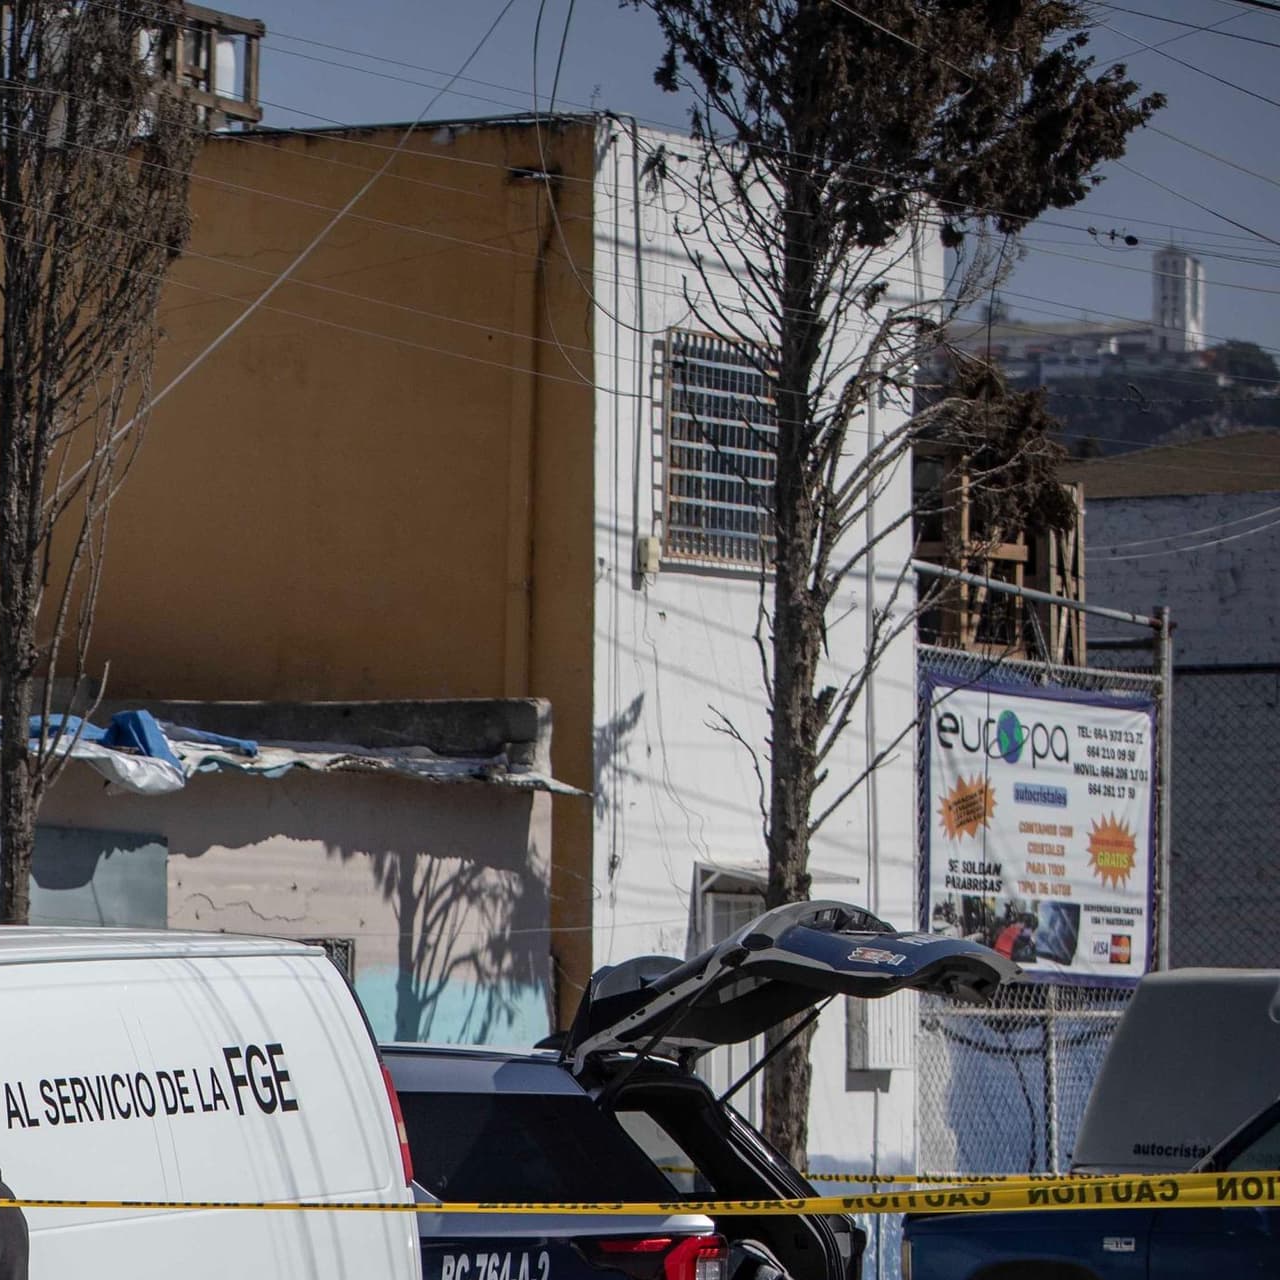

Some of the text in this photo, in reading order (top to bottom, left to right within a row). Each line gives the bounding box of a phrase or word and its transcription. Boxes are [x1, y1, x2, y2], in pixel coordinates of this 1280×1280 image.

[937, 710, 1070, 769] europa
[945, 874, 1003, 892] PARABRISAS
[4, 1043, 299, 1129] AL SERVICIO DE LA FGE
